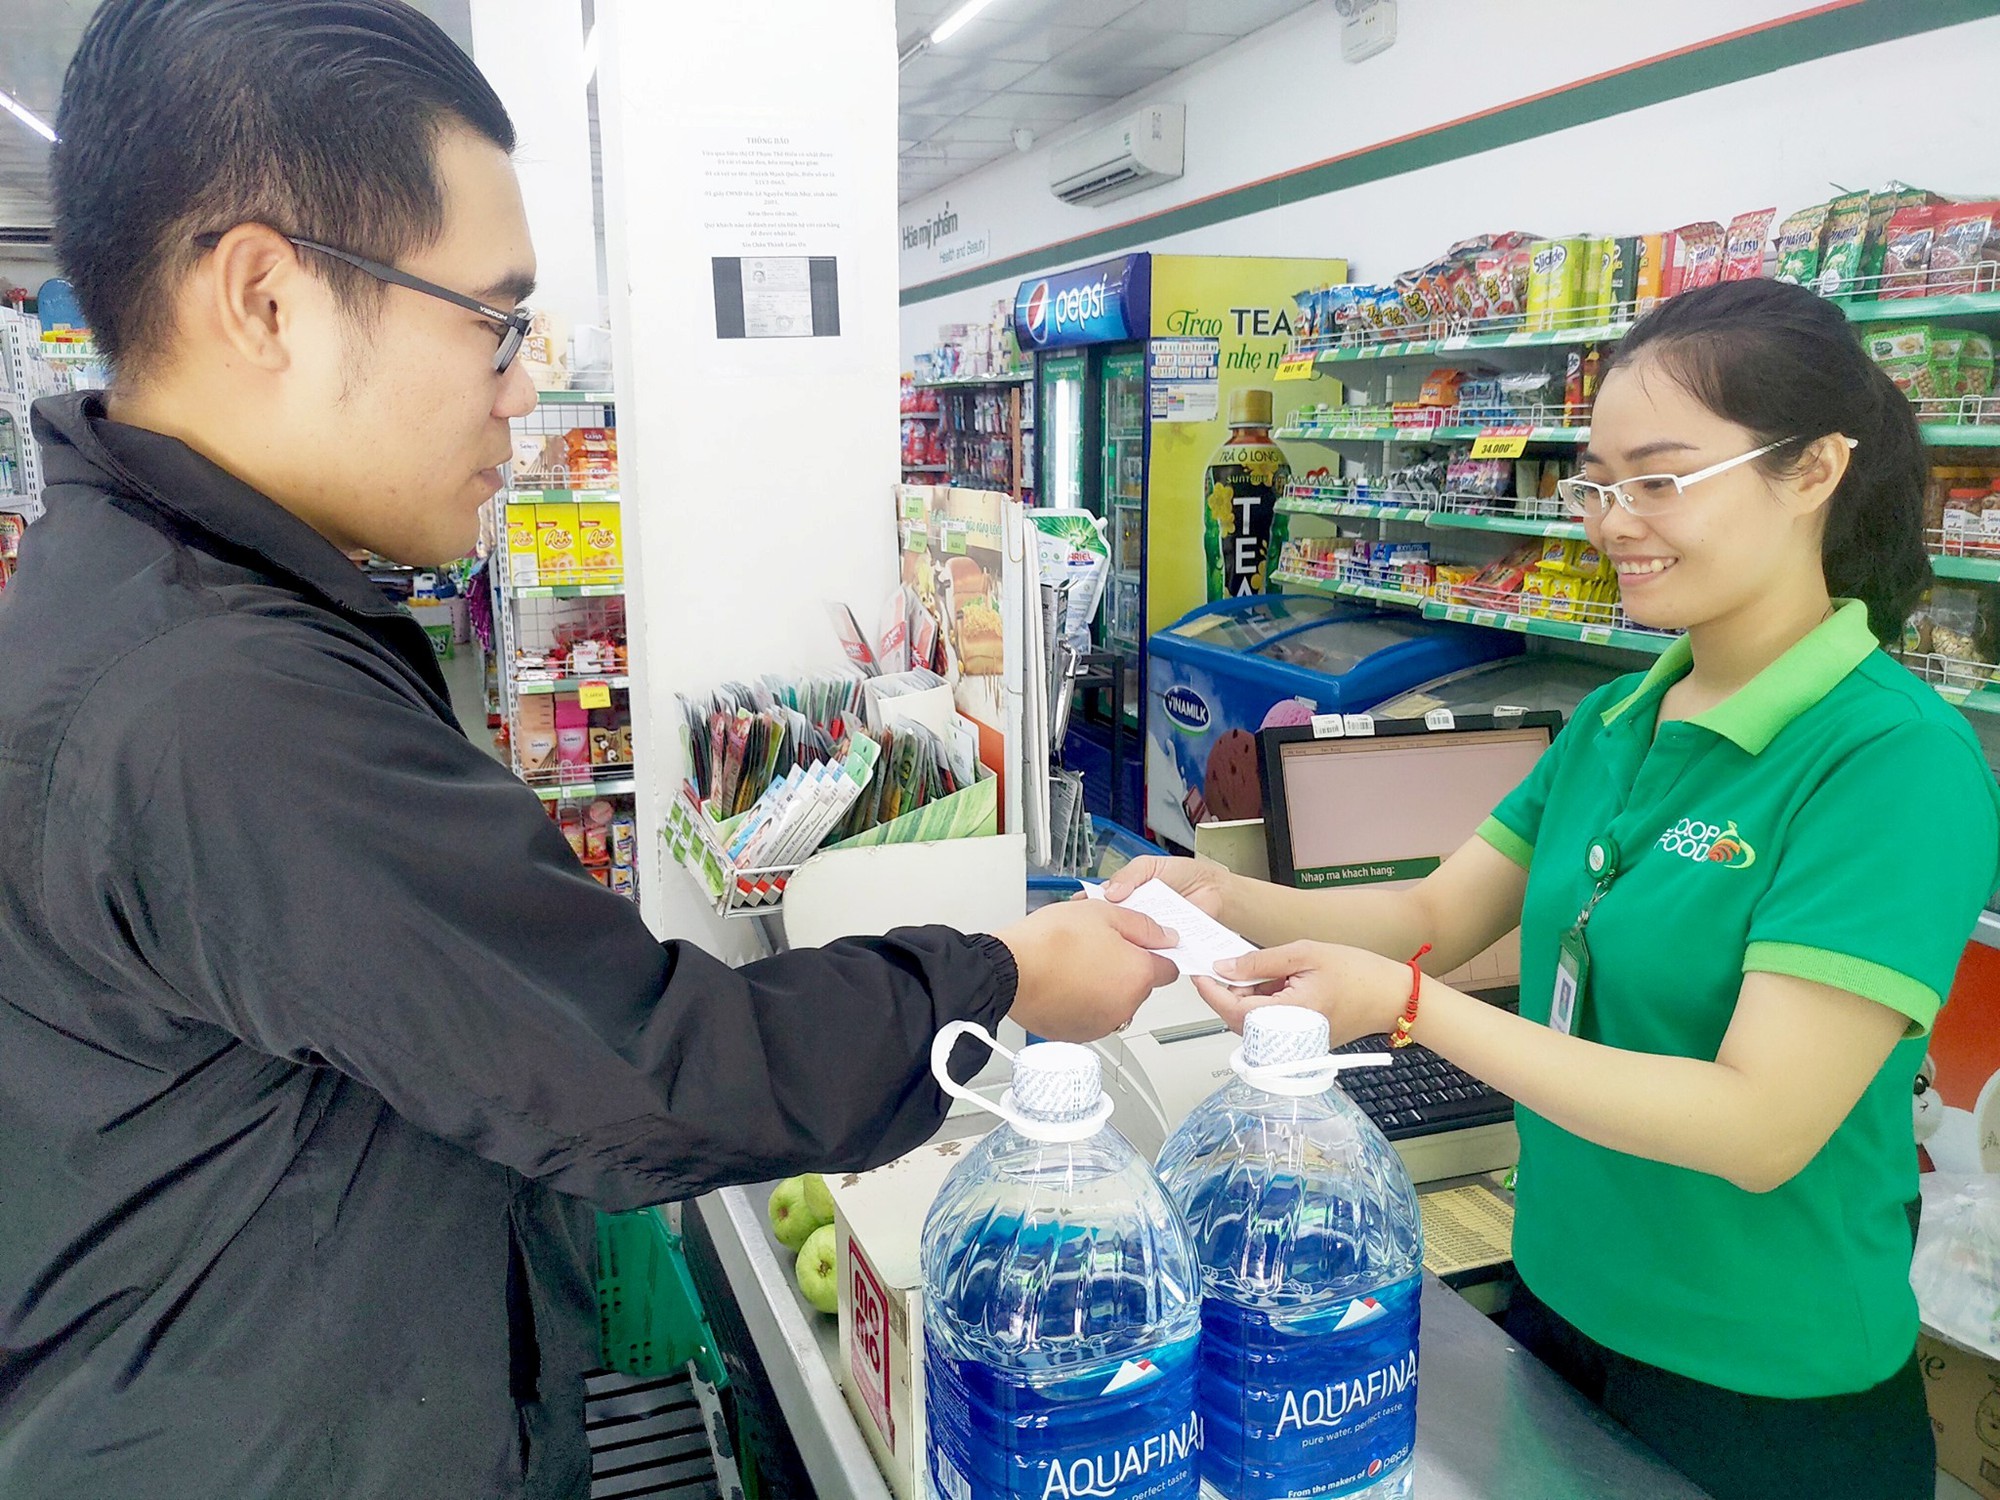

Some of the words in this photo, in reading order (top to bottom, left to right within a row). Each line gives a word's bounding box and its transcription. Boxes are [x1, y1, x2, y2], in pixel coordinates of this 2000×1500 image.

[1055, 273, 1108, 333] pepsi
[1167, 309, 1222, 337] Trao
[1231, 309, 1293, 337] TEA
[1226, 344, 1260, 369] nhẹ
[1068, 551, 1094, 561] ARIEL
[1167, 694, 1207, 723] VINAMILK
[1301, 872, 1325, 883] Nhap
[1326, 872, 1340, 880] ma
[1341, 867, 1369, 879] khach
[1370, 865, 1395, 877] hang:
[1211, 1067, 1235, 1079] EPSO
[1274, 1349, 1417, 1438] AQUAFINA
[1301, 1436, 1325, 1449] pure
[1354, 1411, 1381, 1434] perfect
[1382, 1402, 1403, 1416] taste
[1042, 1410, 1199, 1500] AQUAFINA
[1131, 1481, 1166, 1500] perfect
[1167, 1469, 1188, 1486] taste
[1288, 1486, 1311, 1499] From
[1312, 1482, 1326, 1494] the
[1327, 1475, 1356, 1490] makers
[1357, 1469, 1366, 1479] of
[1383, 1442, 1409, 1470] pepsi
